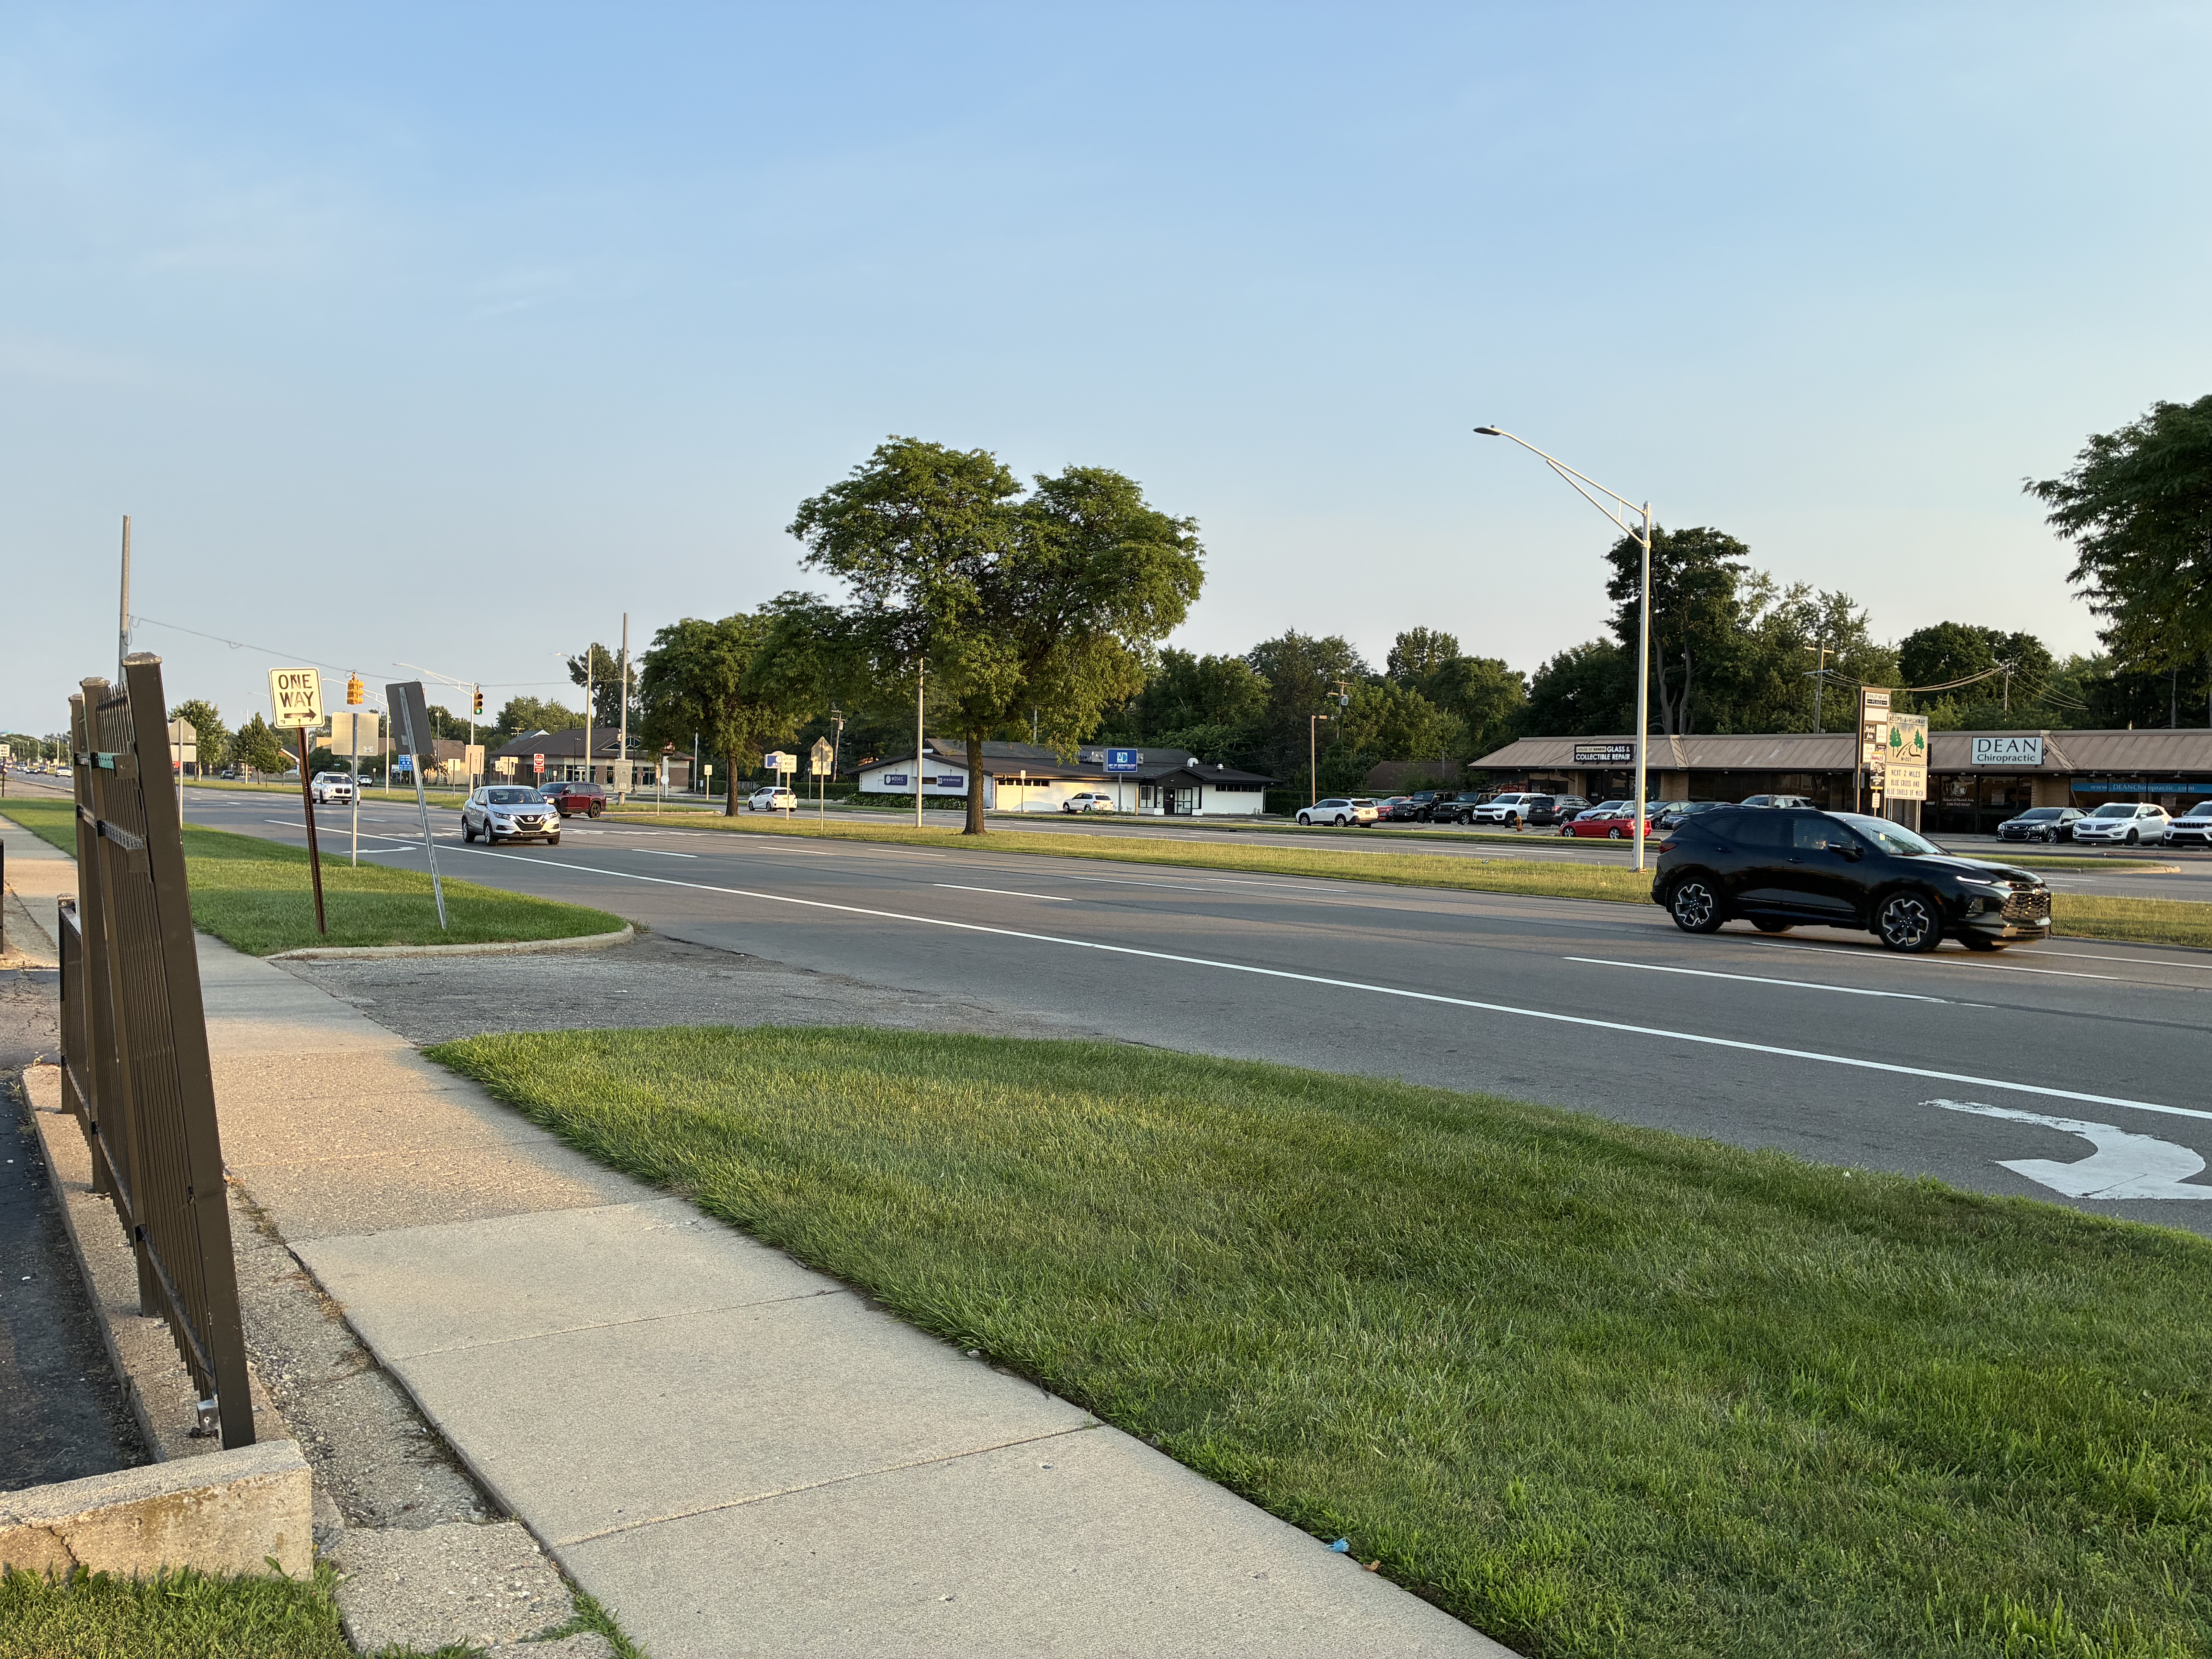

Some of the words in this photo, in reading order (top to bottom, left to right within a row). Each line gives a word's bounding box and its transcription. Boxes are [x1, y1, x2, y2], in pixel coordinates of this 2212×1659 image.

[278, 674, 312, 689] ONE
[279, 691, 314, 707] WAY
[1978, 739, 2036, 752] DEAN
[1977, 754, 2035, 763] Chiropractic
